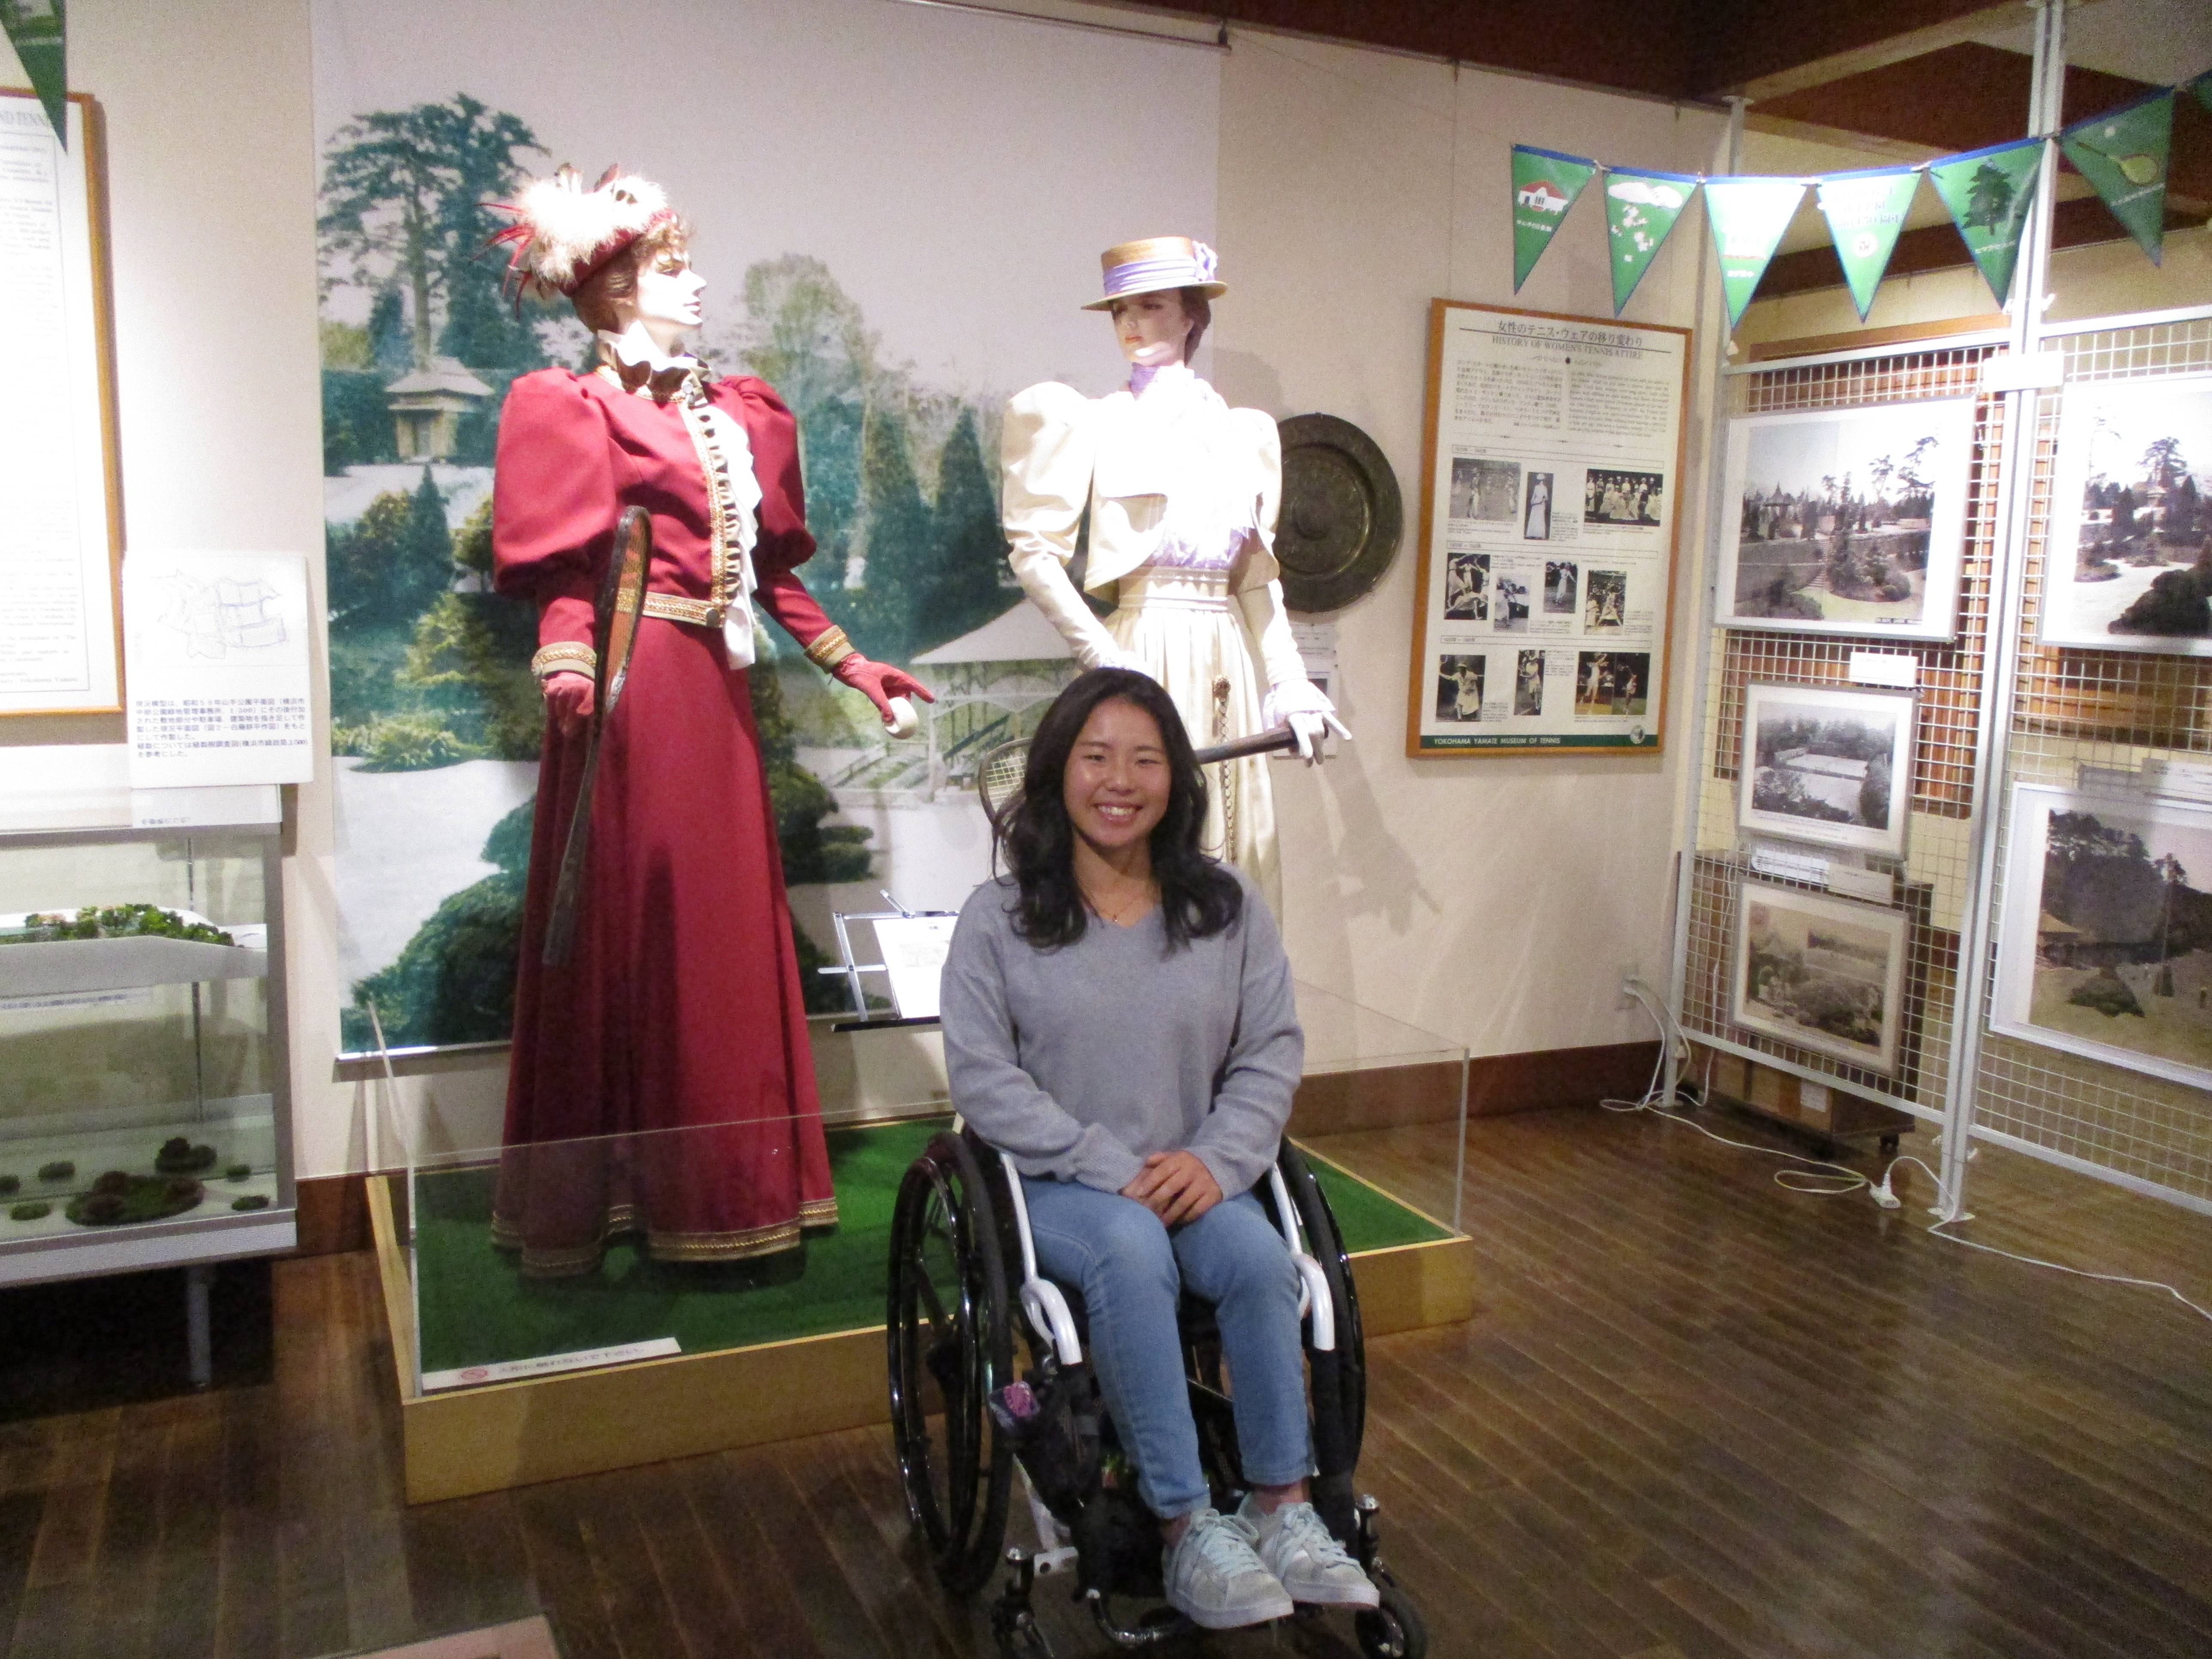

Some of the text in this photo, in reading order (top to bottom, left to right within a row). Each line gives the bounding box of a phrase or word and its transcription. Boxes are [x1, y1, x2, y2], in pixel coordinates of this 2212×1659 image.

[1498, 320, 1643, 347] 女性のテニス・ウェアの移り変わり
[1492, 336, 1529, 347] HISTORY
[1530, 339, 1541, 349] OF
[1583, 346, 1612, 356] TENNIS
[1613, 348, 1643, 359] ATTIRE
